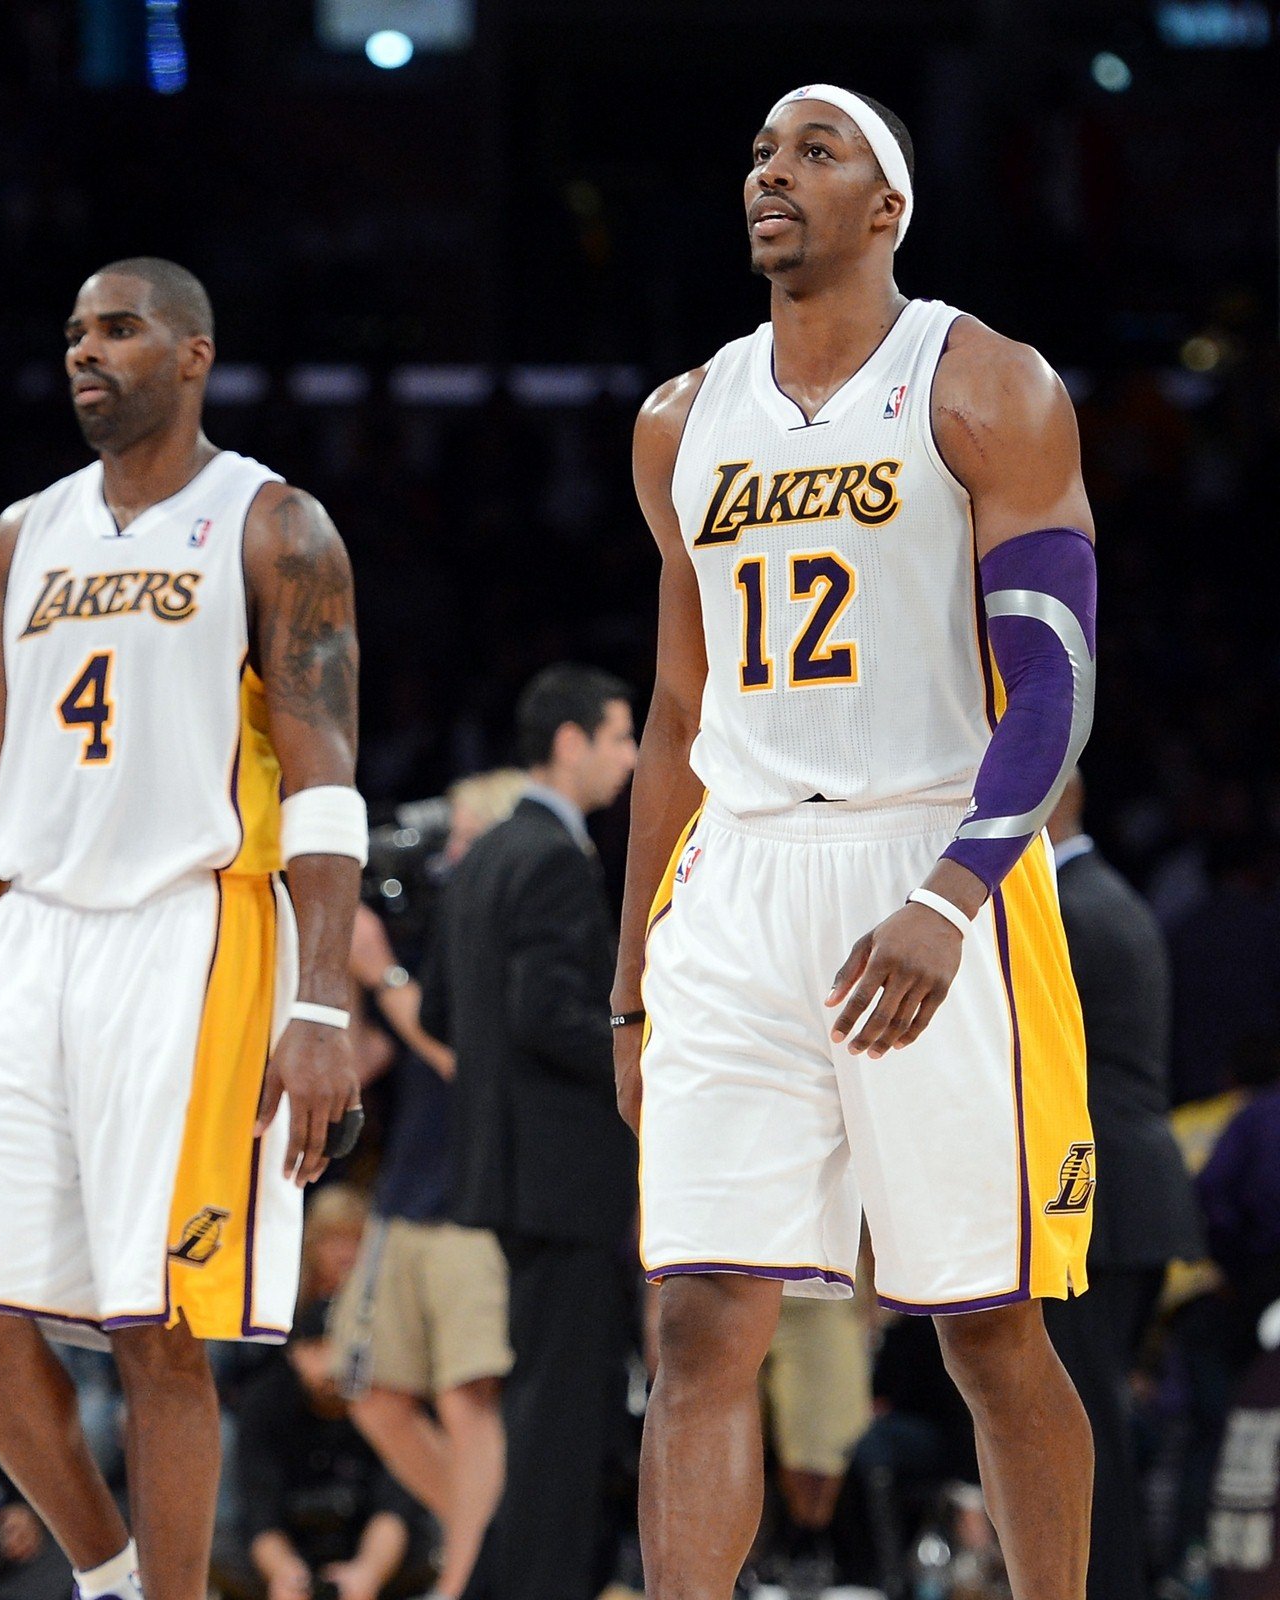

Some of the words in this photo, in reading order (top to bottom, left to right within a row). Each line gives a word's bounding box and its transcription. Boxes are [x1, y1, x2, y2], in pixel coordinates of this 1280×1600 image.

[692, 457, 904, 550] LAKERS
[17, 567, 203, 642] LAKERS
[733, 551, 858, 692] 12
[56, 650, 115, 765] 4
